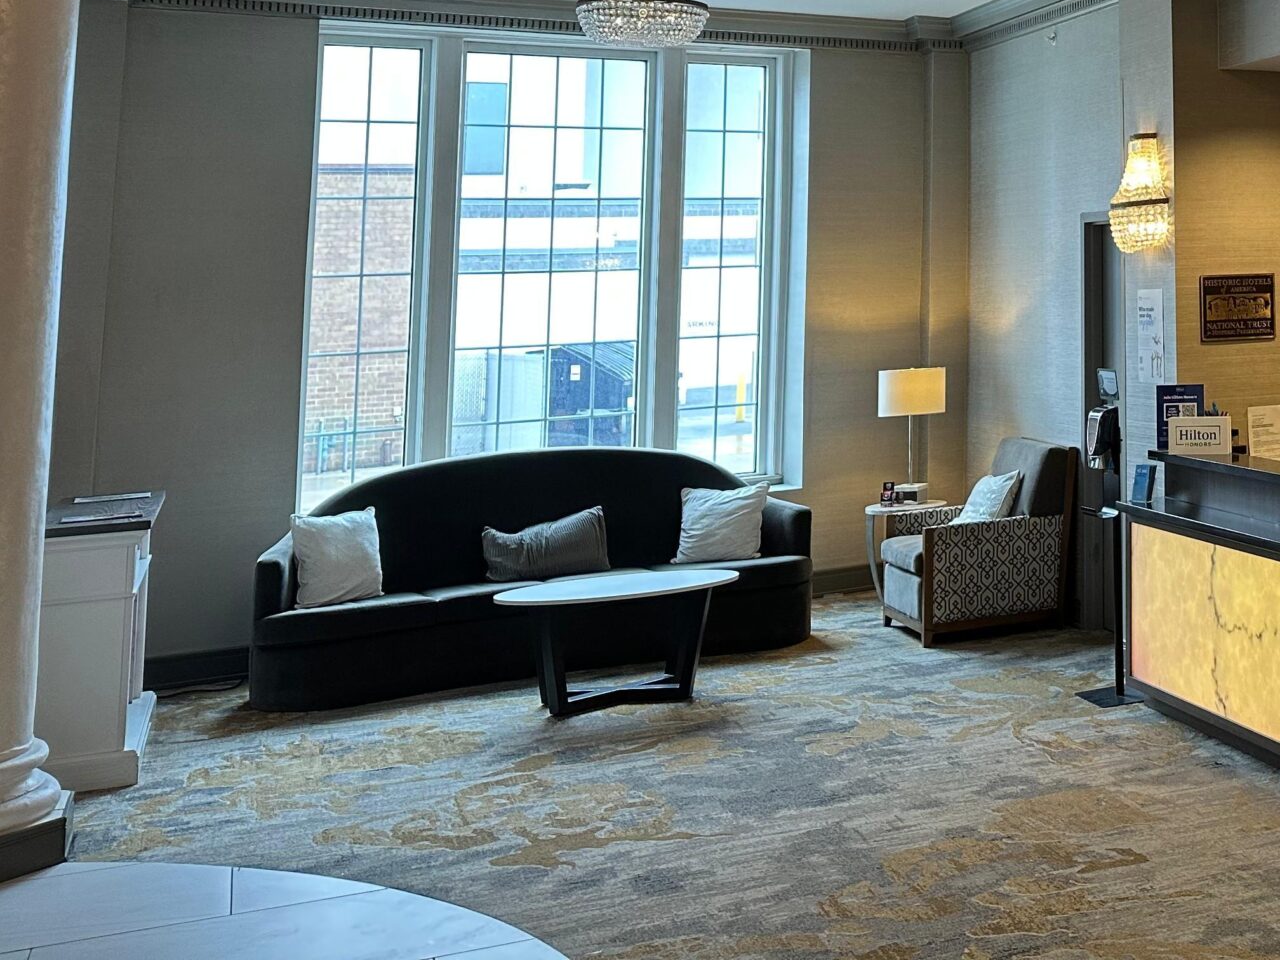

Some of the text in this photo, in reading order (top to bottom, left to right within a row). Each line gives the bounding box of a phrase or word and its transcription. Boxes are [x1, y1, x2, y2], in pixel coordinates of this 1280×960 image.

[1204, 279, 1241, 287] HISTORIC
[1207, 320, 1272, 330] NATIONAL TRUST
[1179, 429, 1217, 441] Hilton
